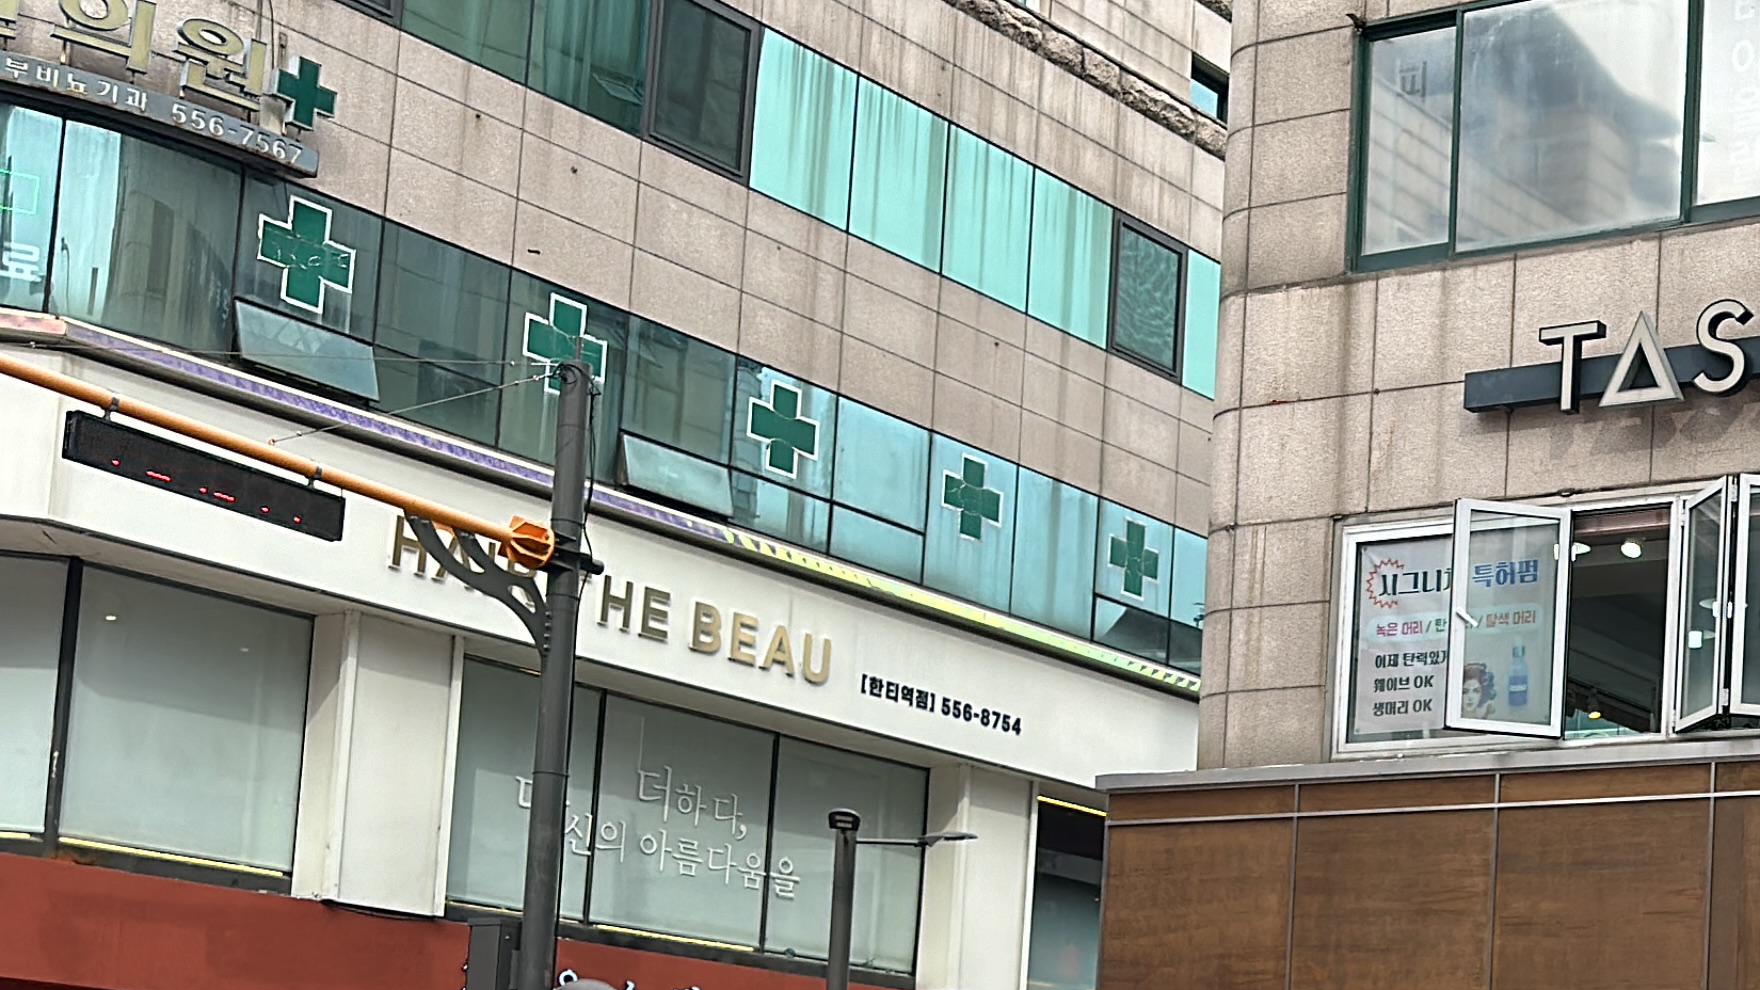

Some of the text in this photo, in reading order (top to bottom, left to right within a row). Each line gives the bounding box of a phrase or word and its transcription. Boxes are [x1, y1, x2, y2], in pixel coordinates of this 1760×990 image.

[0, 0, 268, 112] 의원
[171, 103, 304, 164] 556-7567
[1472, 559, 1540, 588] 특허펌
[688, 600, 833, 687] BEAU
[1401, 620, 1424, 636] 머리
[1512, 609, 1537, 626] 머리
[1375, 652, 1399, 669] 이제
[1413, 674, 1435, 690] OK
[860, 673, 1022, 737] [한티역점] 556-8754
[1372, 698, 1433, 717] 생머리 OK
[639, 828, 801, 899] 아름다움을
